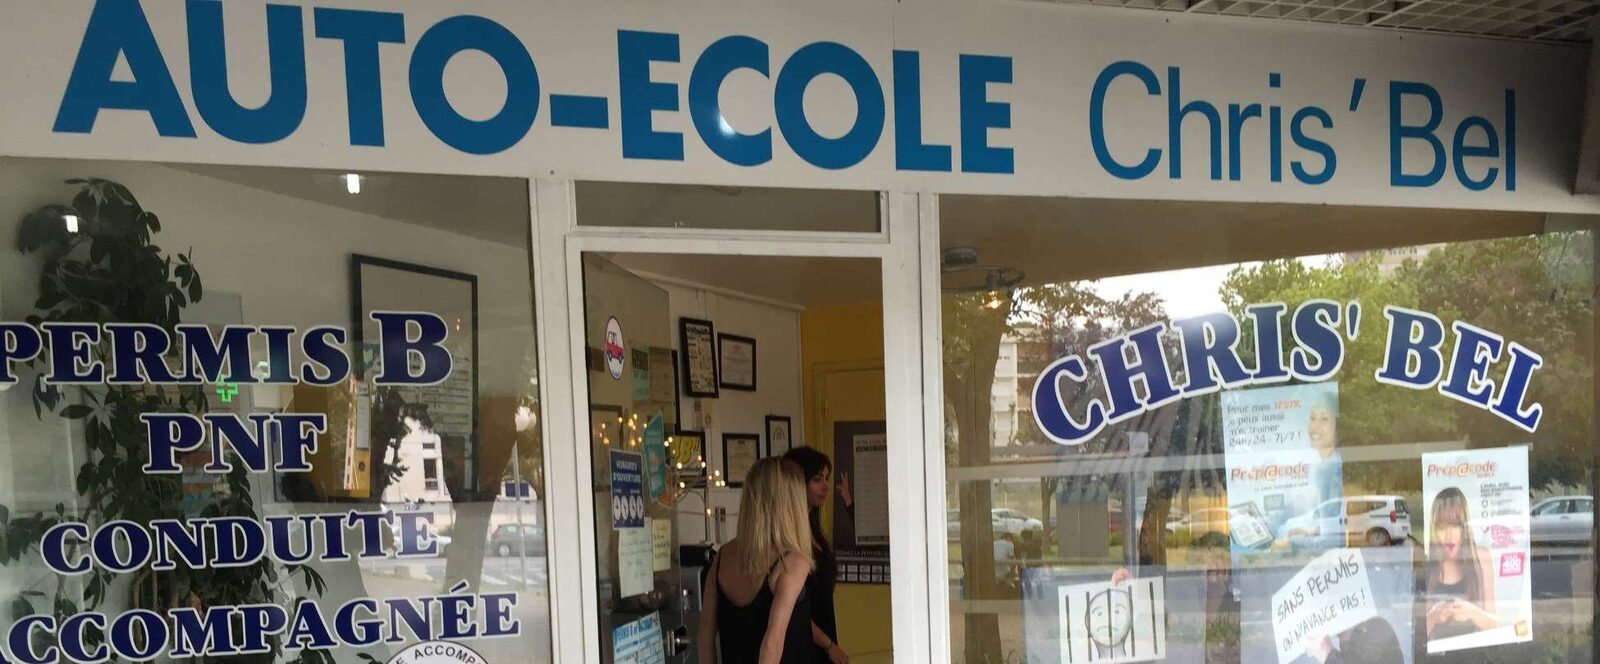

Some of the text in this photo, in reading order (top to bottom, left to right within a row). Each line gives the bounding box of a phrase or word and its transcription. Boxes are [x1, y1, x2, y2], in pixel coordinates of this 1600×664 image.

[52, 0, 1517, 191] AUTO-ECOLE Chris' Bel
[0, 310, 454, 387] PERMIS B
[1032, 298, 1543, 446] CHRIS' BEL
[1227, 404, 1249, 414] Pour
[141, 412, 327, 474] PNF
[41, 512, 439, 576] CONDUITE
[0, 581, 522, 664] CCOMPAGNÉE
[1277, 554, 1359, 624] SANS PERMIS
[1340, 591, 1360, 611] PAS
[414, 645, 481, 664] ACCOMP
